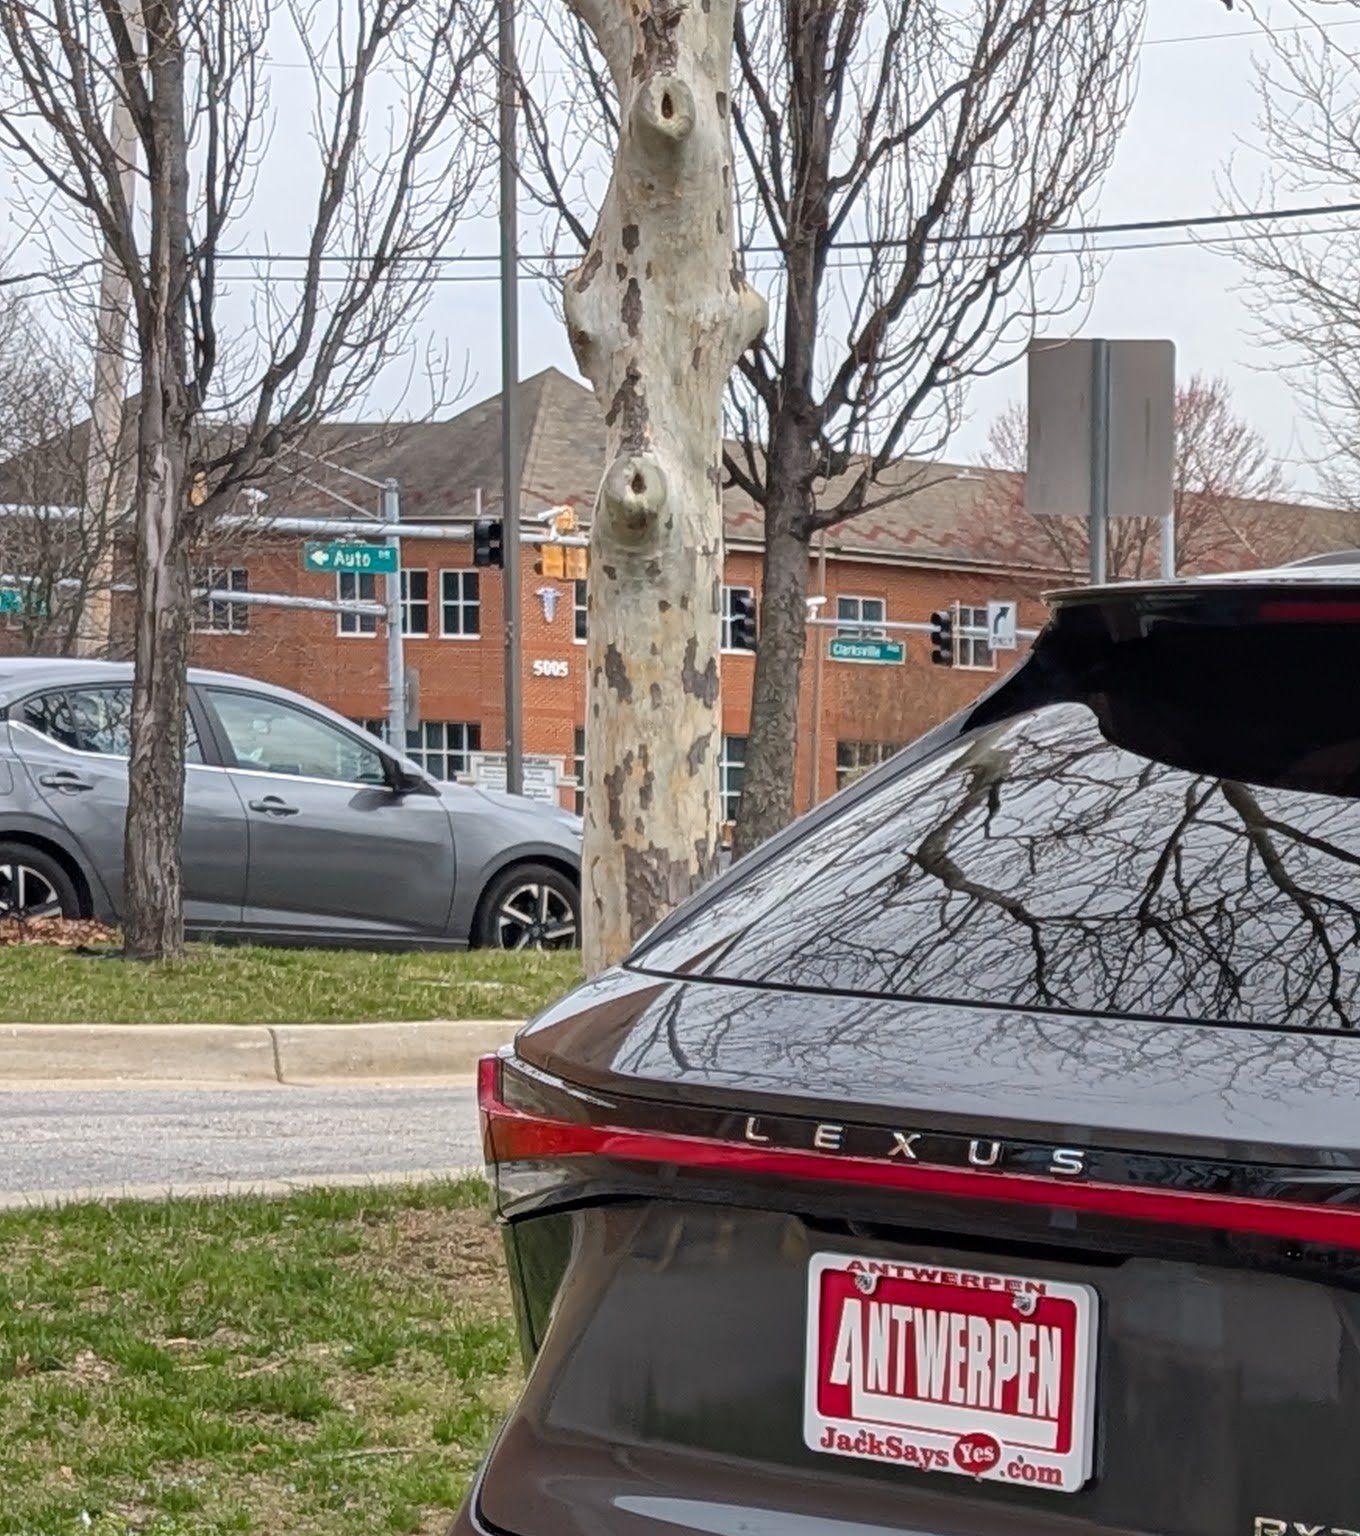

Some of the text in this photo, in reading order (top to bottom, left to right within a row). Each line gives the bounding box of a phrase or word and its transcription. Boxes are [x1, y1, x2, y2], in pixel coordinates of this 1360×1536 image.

[333, 550, 371, 567] Auto
[533, 660, 569, 677] 5005
[744, 1117, 1085, 1175] LEXUS
[846, 1260, 1047, 1297] ANTWERPEN
[829, 1297, 1062, 1420] ANTWERPEN
